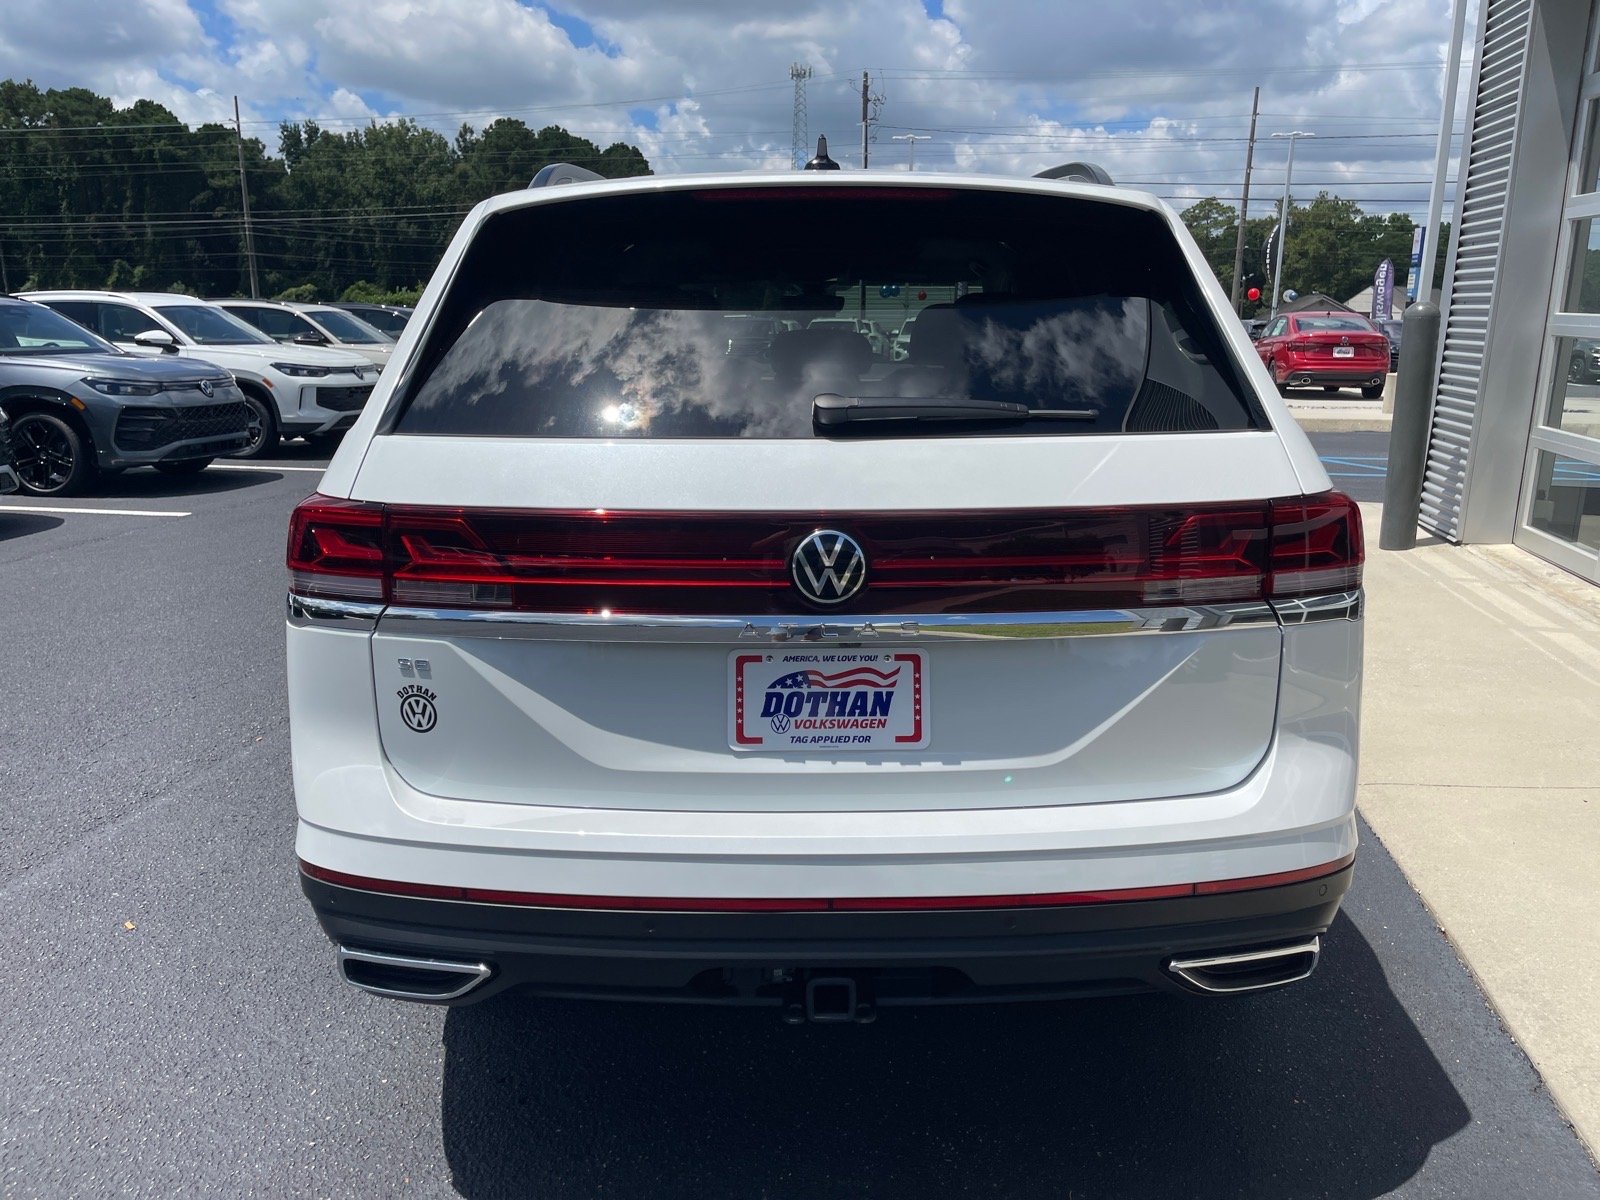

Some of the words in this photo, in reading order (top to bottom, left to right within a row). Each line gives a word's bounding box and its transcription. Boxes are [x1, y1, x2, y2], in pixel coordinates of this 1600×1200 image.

[792, 530, 865, 603] VW
[738, 621, 920, 639] ATLAS
[782, 655, 820, 663] AMERICA,
[822, 654, 837, 663] WE
[837, 654, 858, 662] LOVE
[859, 654, 879, 662] YOU!
[397, 684, 437, 702] DOTHAN
[400, 693, 438, 734] VW
[760, 691, 894, 718] DOTHAN
[794, 719, 888, 730] VOLKSWAGEN
[790, 736, 809, 744] TAG
[809, 736, 851, 744] APPLIED
[852, 735, 872, 744] FOR
